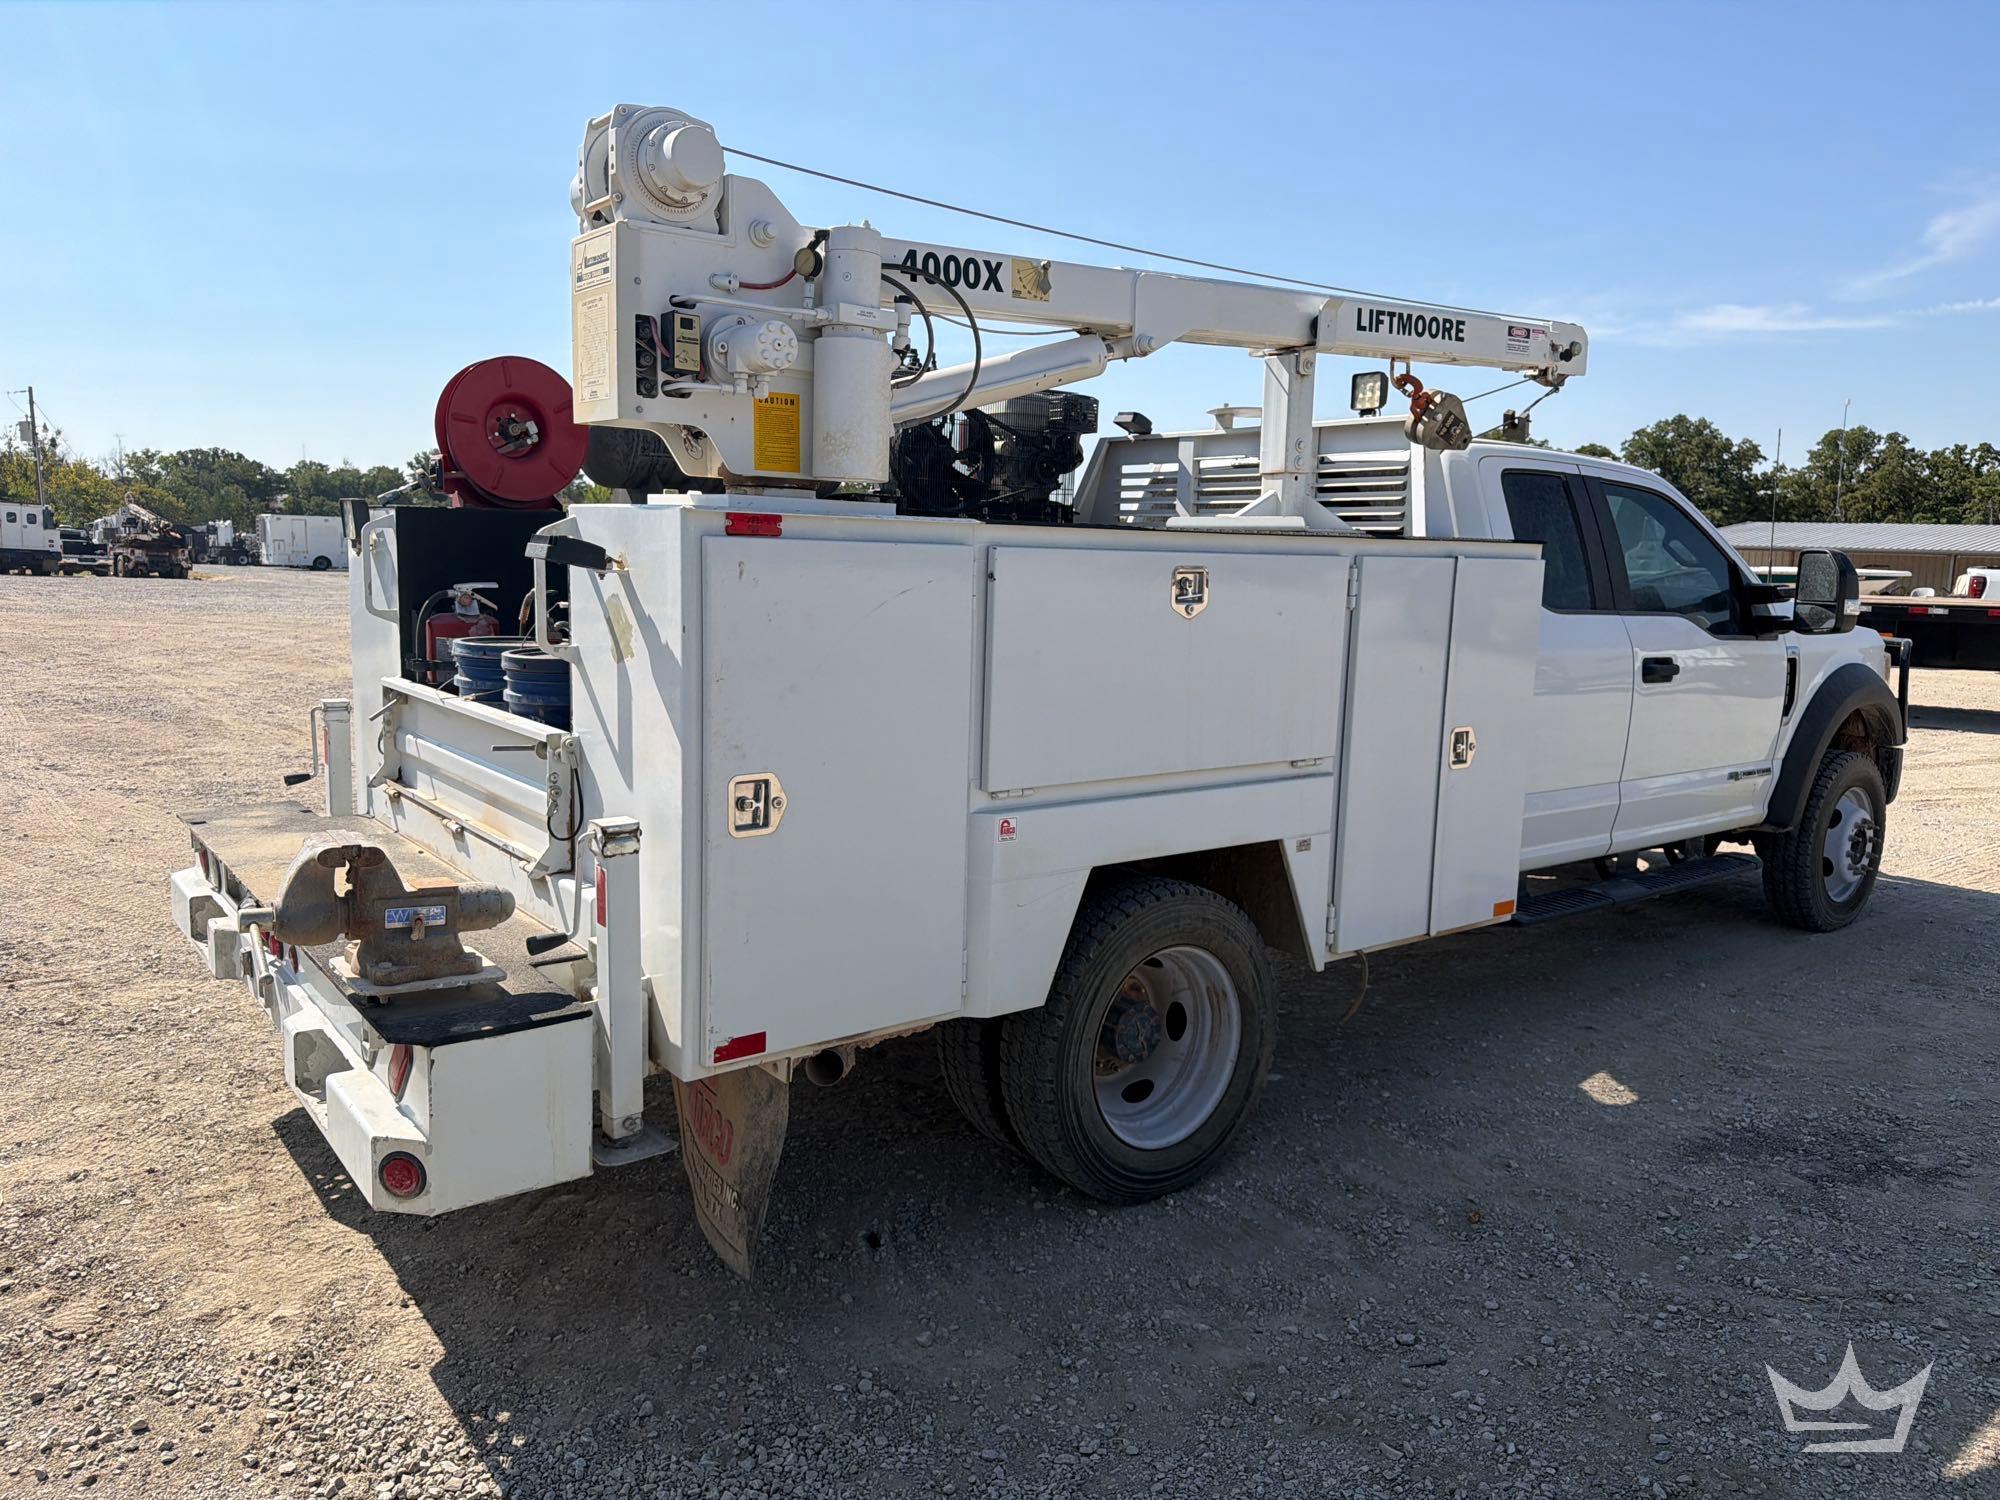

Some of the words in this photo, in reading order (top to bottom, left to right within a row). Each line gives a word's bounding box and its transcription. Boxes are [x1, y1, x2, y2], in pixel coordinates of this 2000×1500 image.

[901, 249, 1004, 293] 4000X
[1356, 307, 1466, 343] LIFTMOORE
[758, 397, 795, 406] CAUTION
